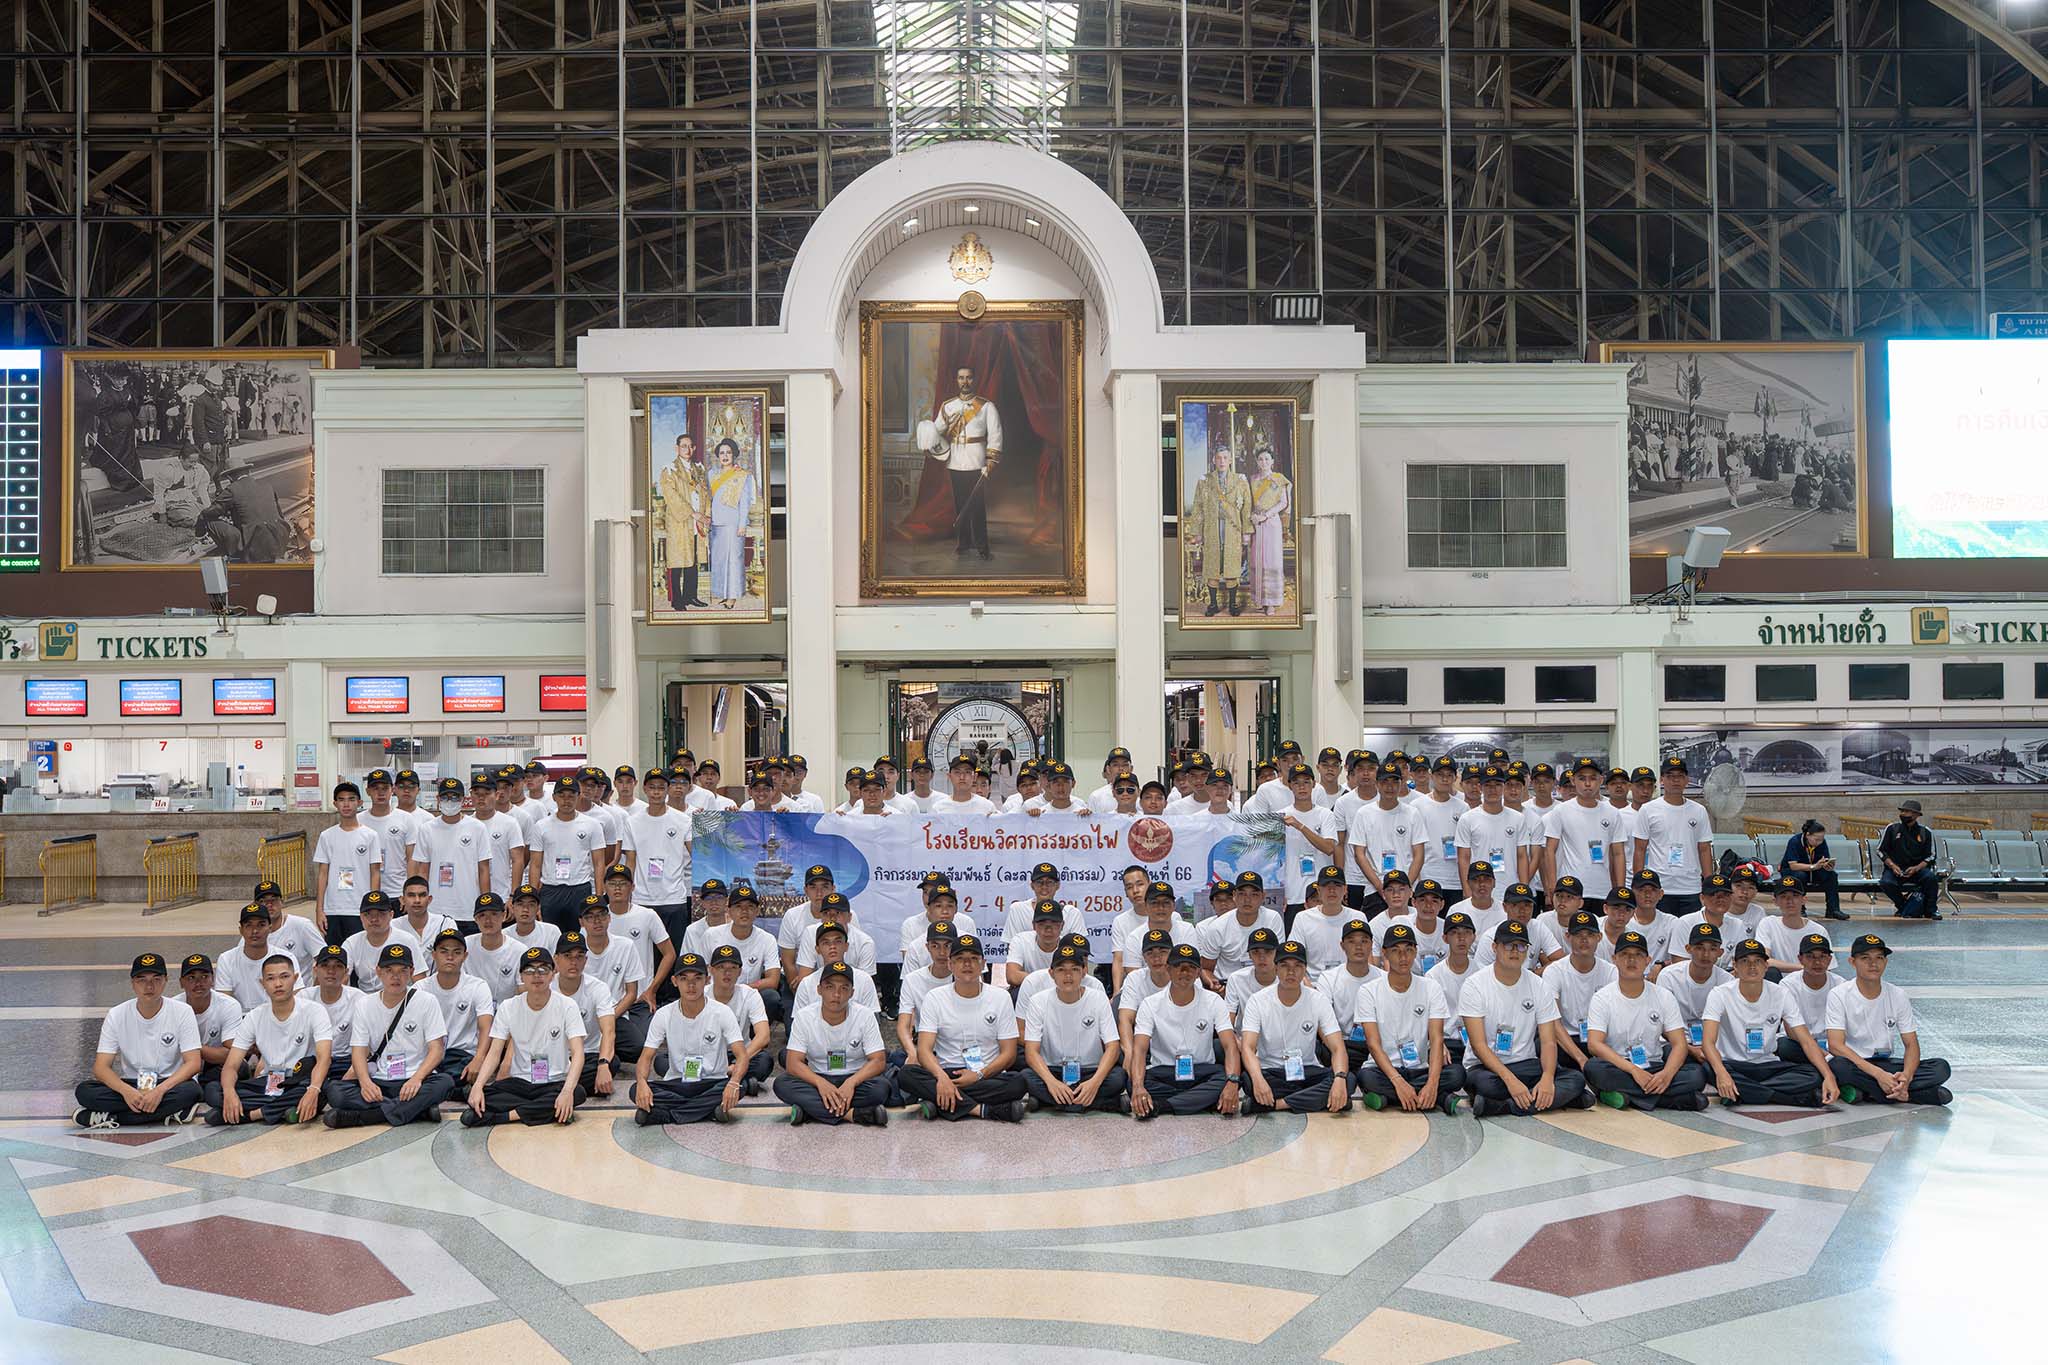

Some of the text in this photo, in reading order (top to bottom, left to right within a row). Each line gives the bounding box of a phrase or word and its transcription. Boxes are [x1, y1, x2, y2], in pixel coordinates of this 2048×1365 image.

[1758, 607, 1886, 644] จำหน่ายตั๋ว
[97, 636, 207, 659] TICKETS
[974, 706, 987, 717] XII
[159, 741, 168, 751] 7
[254, 740, 263, 750] 8
[383, 737, 391, 748] 9
[476, 737, 489, 748] 10
[571, 736, 583, 747] 11
[37, 755, 49, 771] 2
[922, 821, 1119, 850] โรงเรียนวิศวกรรมรถไฟ
[1175, 866, 1192, 881] 66
[963, 896, 973, 912] 2
[994, 895, 1005, 912] 4
[1084, 895, 1123, 912] 2568
